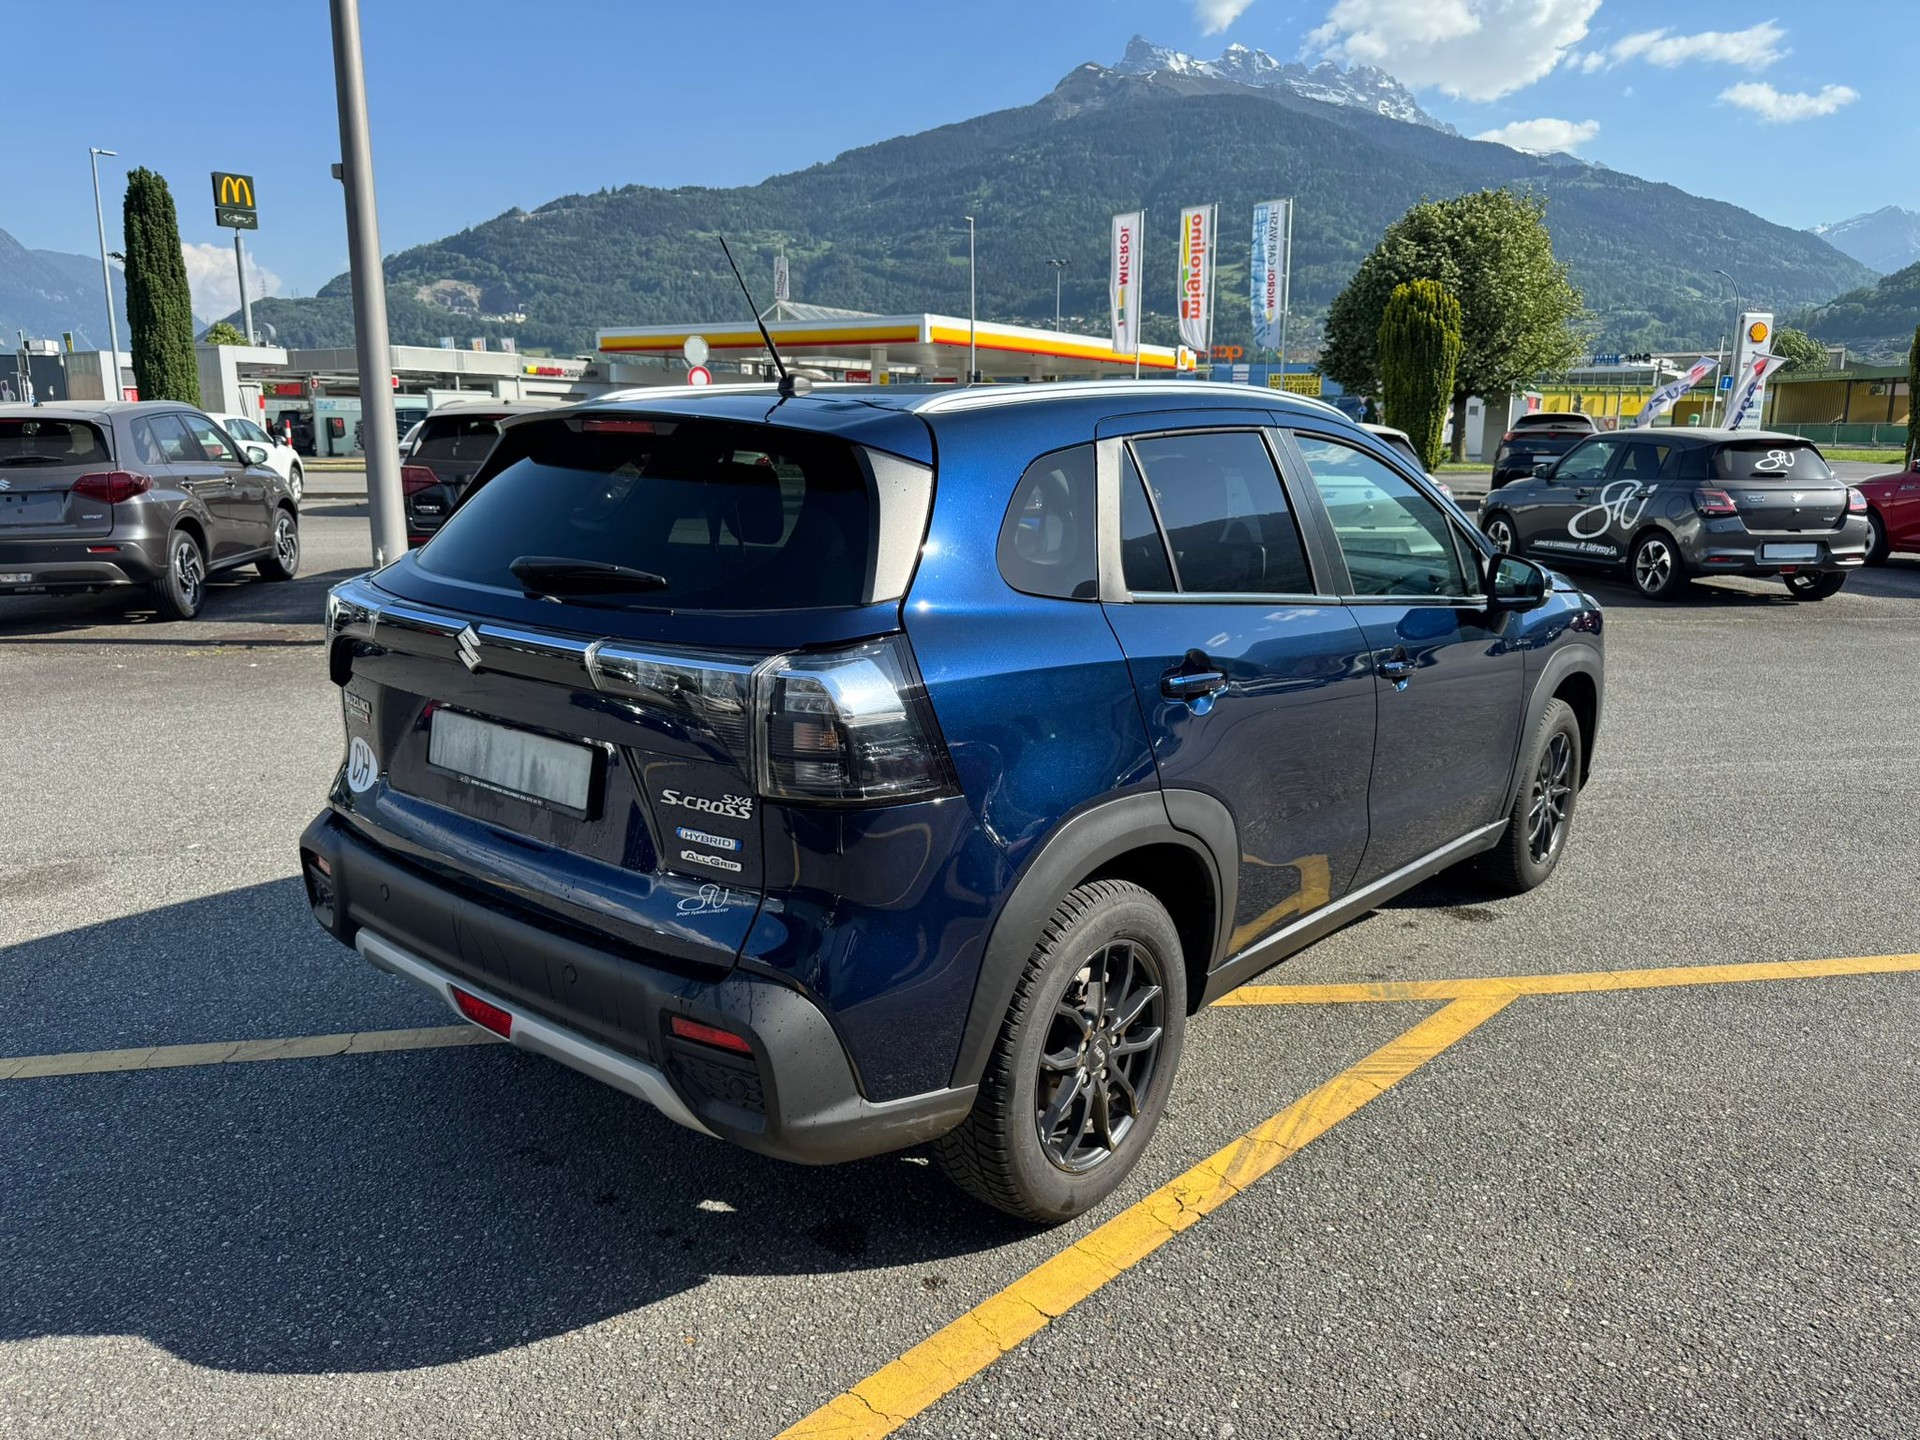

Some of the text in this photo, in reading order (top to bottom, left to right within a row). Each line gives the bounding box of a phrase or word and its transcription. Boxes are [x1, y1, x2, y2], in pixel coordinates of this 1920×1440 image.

[353, 742, 370, 787] CH
[721, 794, 753, 808] SX4
[684, 831, 733, 848] HYBRID
